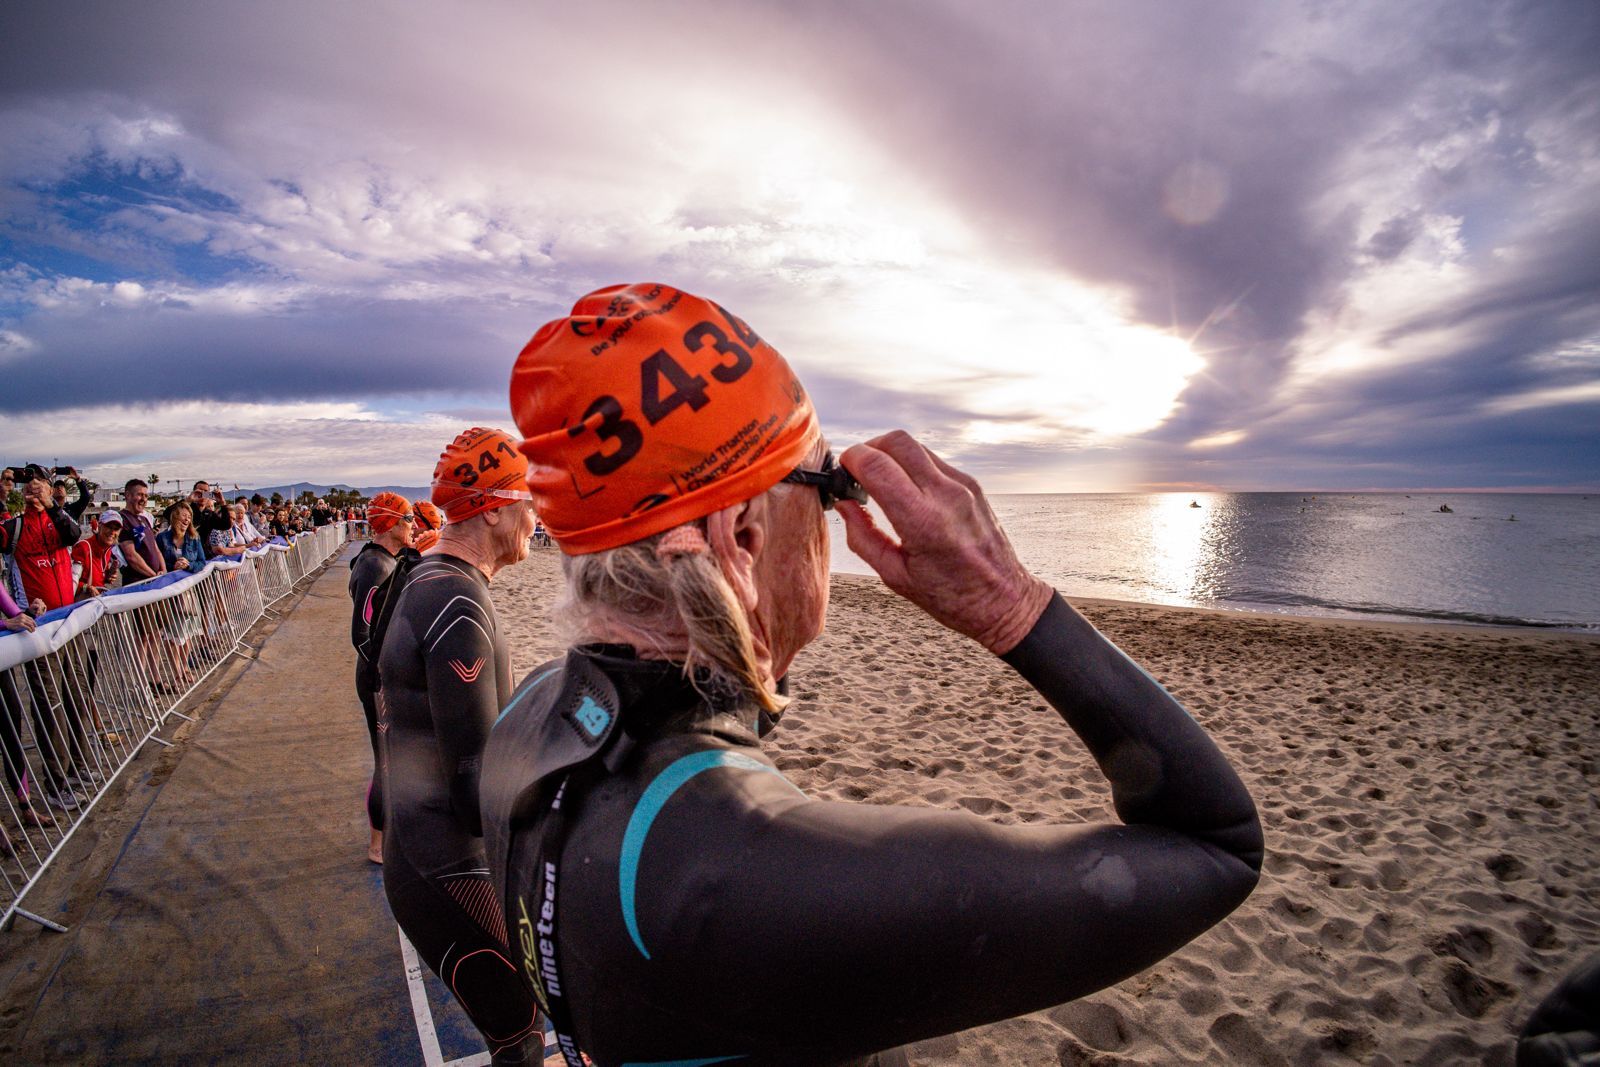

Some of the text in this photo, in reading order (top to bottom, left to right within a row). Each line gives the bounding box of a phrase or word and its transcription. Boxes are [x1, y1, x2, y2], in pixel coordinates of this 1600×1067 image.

[454, 438, 518, 487] 341
[681, 454, 718, 481] World
[716, 419, 760, 457] Triathlon
[537, 862, 563, 997] nineteen
